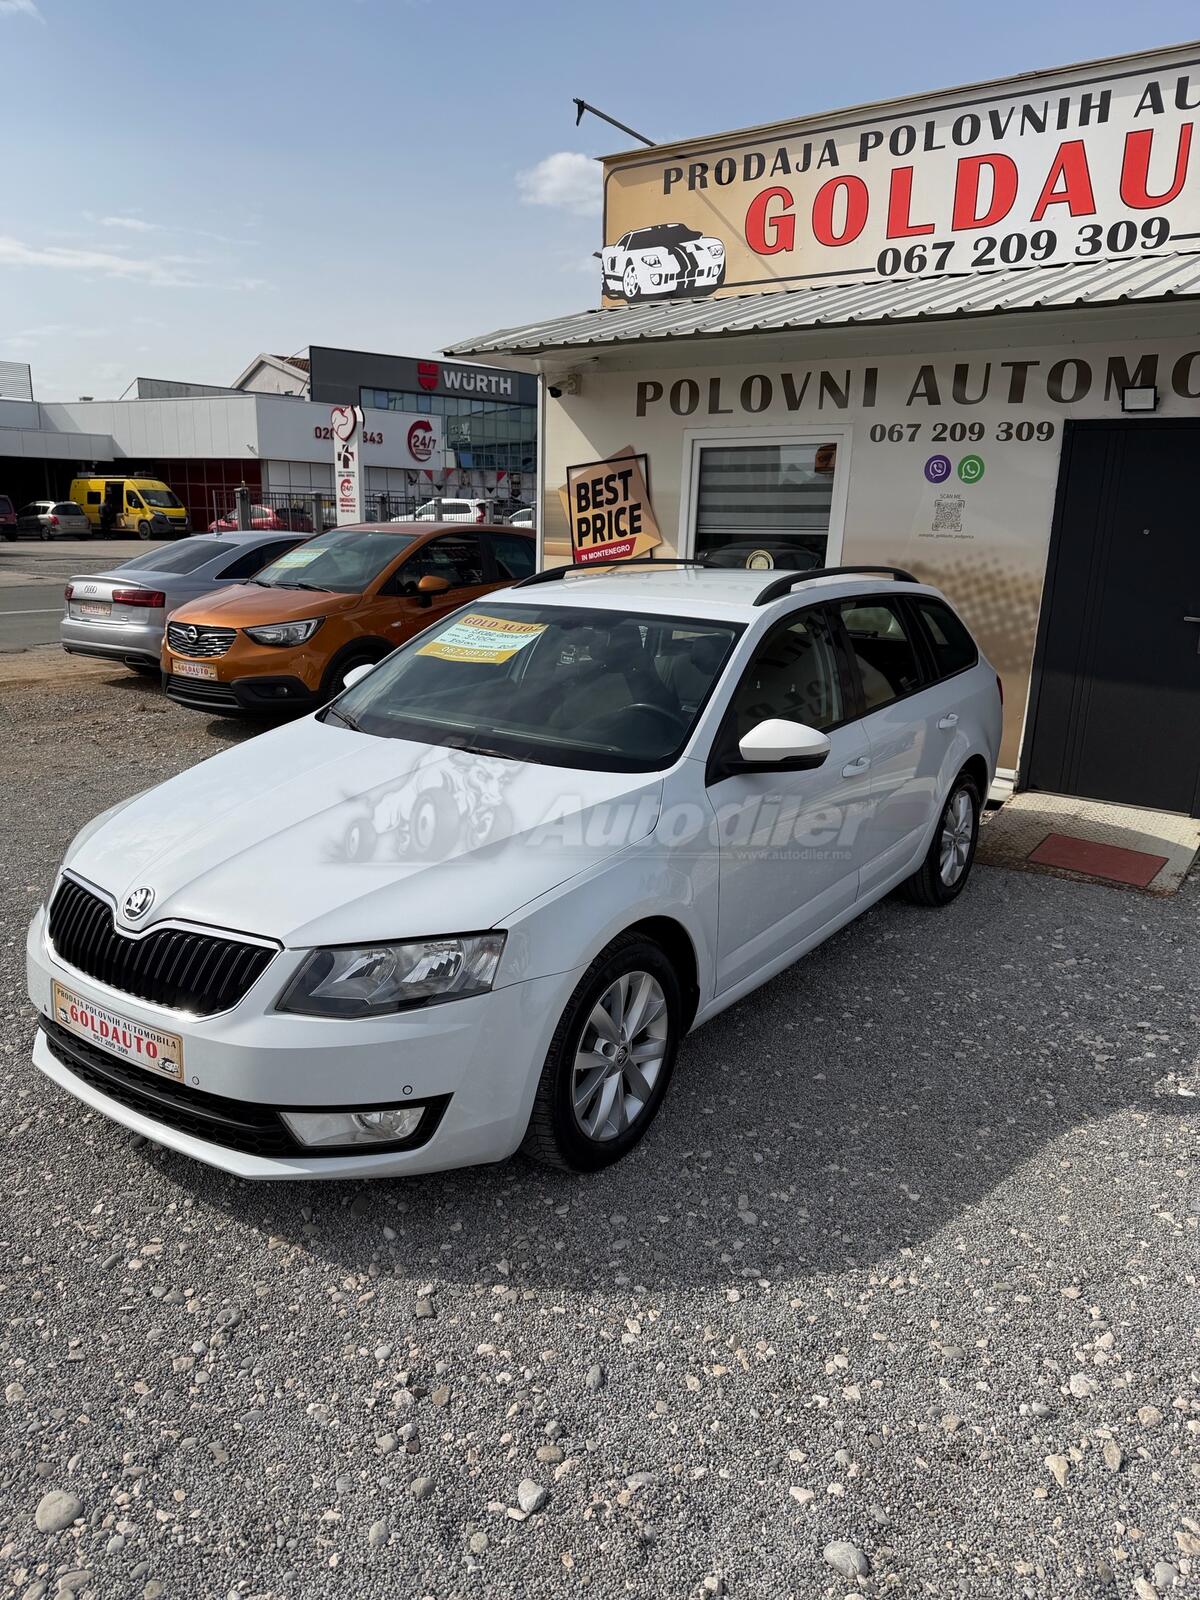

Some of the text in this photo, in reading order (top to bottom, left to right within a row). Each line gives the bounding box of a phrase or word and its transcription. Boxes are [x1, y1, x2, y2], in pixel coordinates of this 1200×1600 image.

[662, 75, 1200, 195] PRODAJA POLOVNIH AU
[744, 121, 1194, 256] GOLDAU
[876, 216, 1171, 277] 067 209 309
[443, 370, 512, 395] WÜRTH
[635, 350, 1200, 417] POLOVNI AUTOMO
[412, 434, 437, 449] 24/7
[869, 421, 1055, 443] 067 209 309
[576, 468, 633, 513] BEST
[576, 502, 642, 548] PRICE
[581, 544, 631, 561] IN MONTENEGRO
[463, 616, 498, 629] GOLD
[501, 622, 533, 633] AUTO
[56, 987, 177, 1049] PRODAJA POLOVNIH AUTOMOBILA
[69, 1005, 158, 1059] GOLDAUTO
